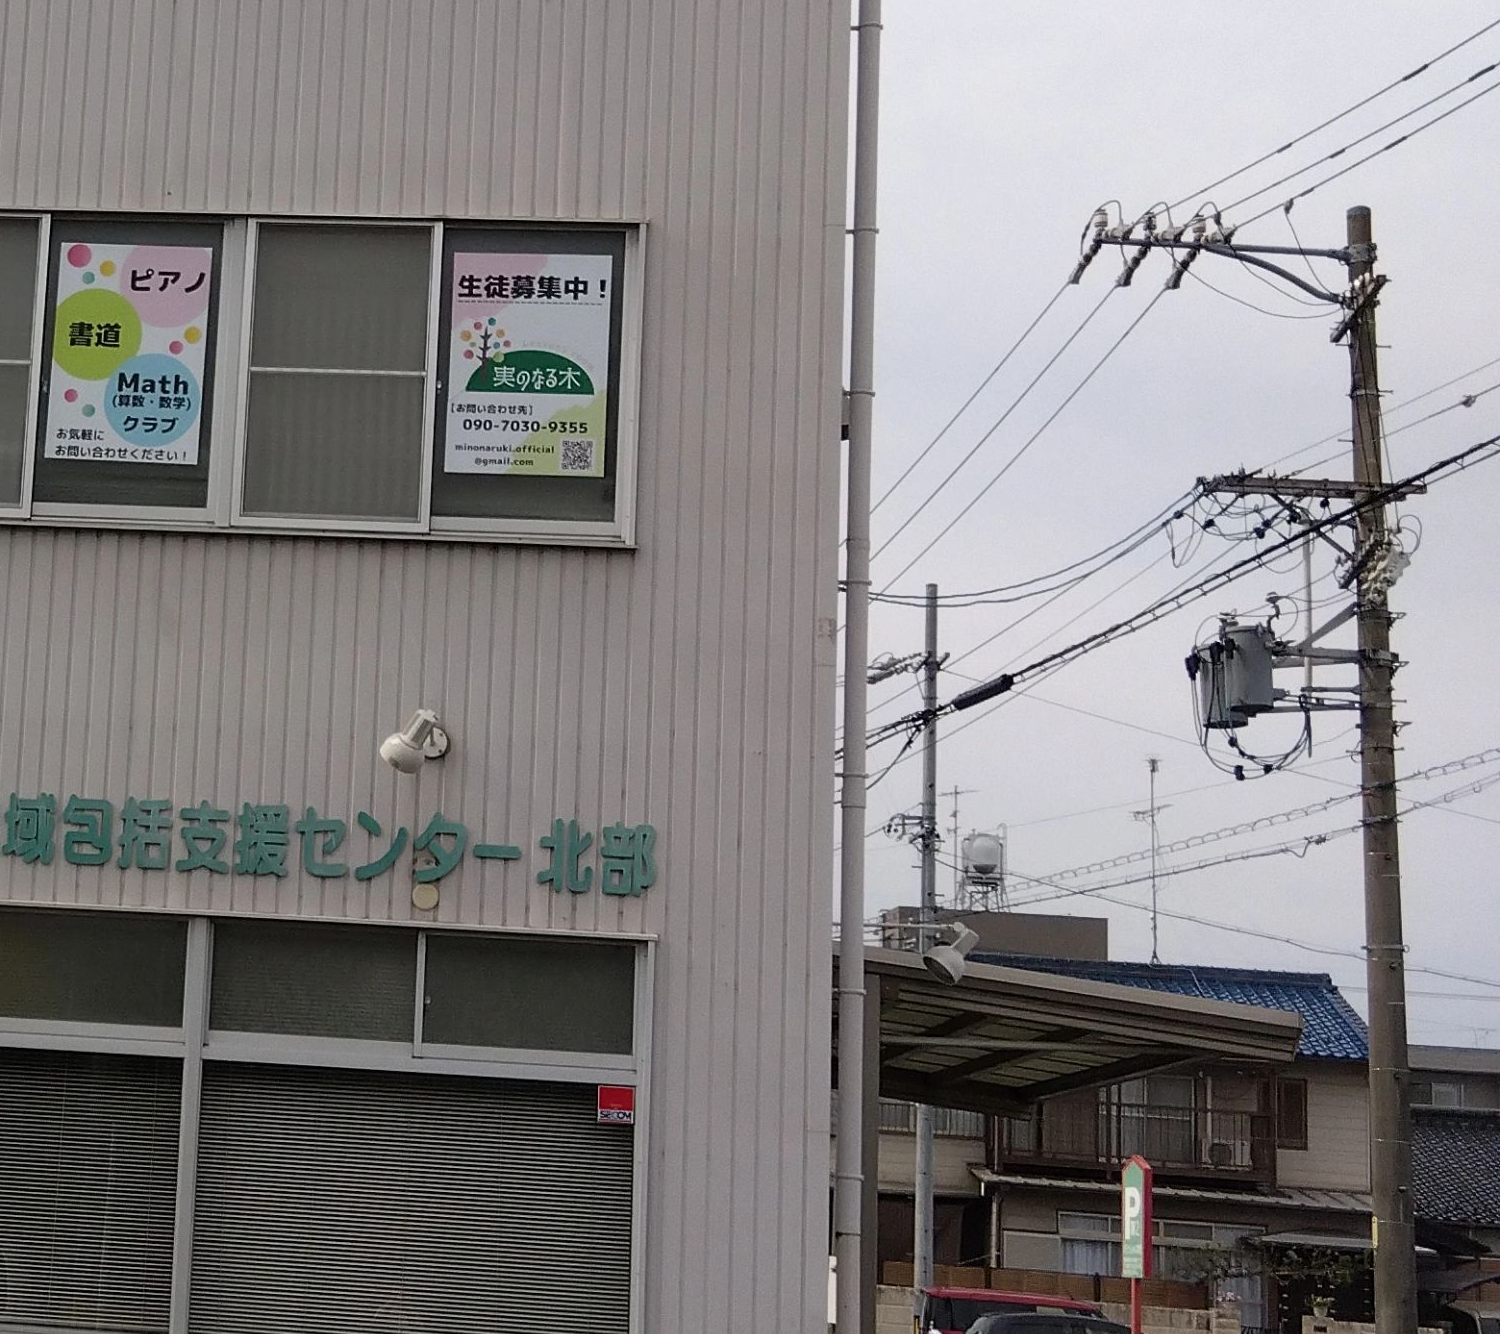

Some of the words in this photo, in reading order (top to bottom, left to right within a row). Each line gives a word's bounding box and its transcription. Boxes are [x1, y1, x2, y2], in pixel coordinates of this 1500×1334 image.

[130, 268, 206, 293] ピアノ
[457, 275, 607, 300] 生徒募集中！
[68, 322, 122, 349] 書道
[116, 372, 189, 395] Math
[493, 366, 581, 391] 実のなる木
[56, 428, 104, 441] お気軽に
[122, 416, 180, 434] クラブ
[463, 418, 588, 434] 090-7030-9355
[474, 457, 534, 468] @gmail.com
[1125, 1187, 1140, 1240] P
